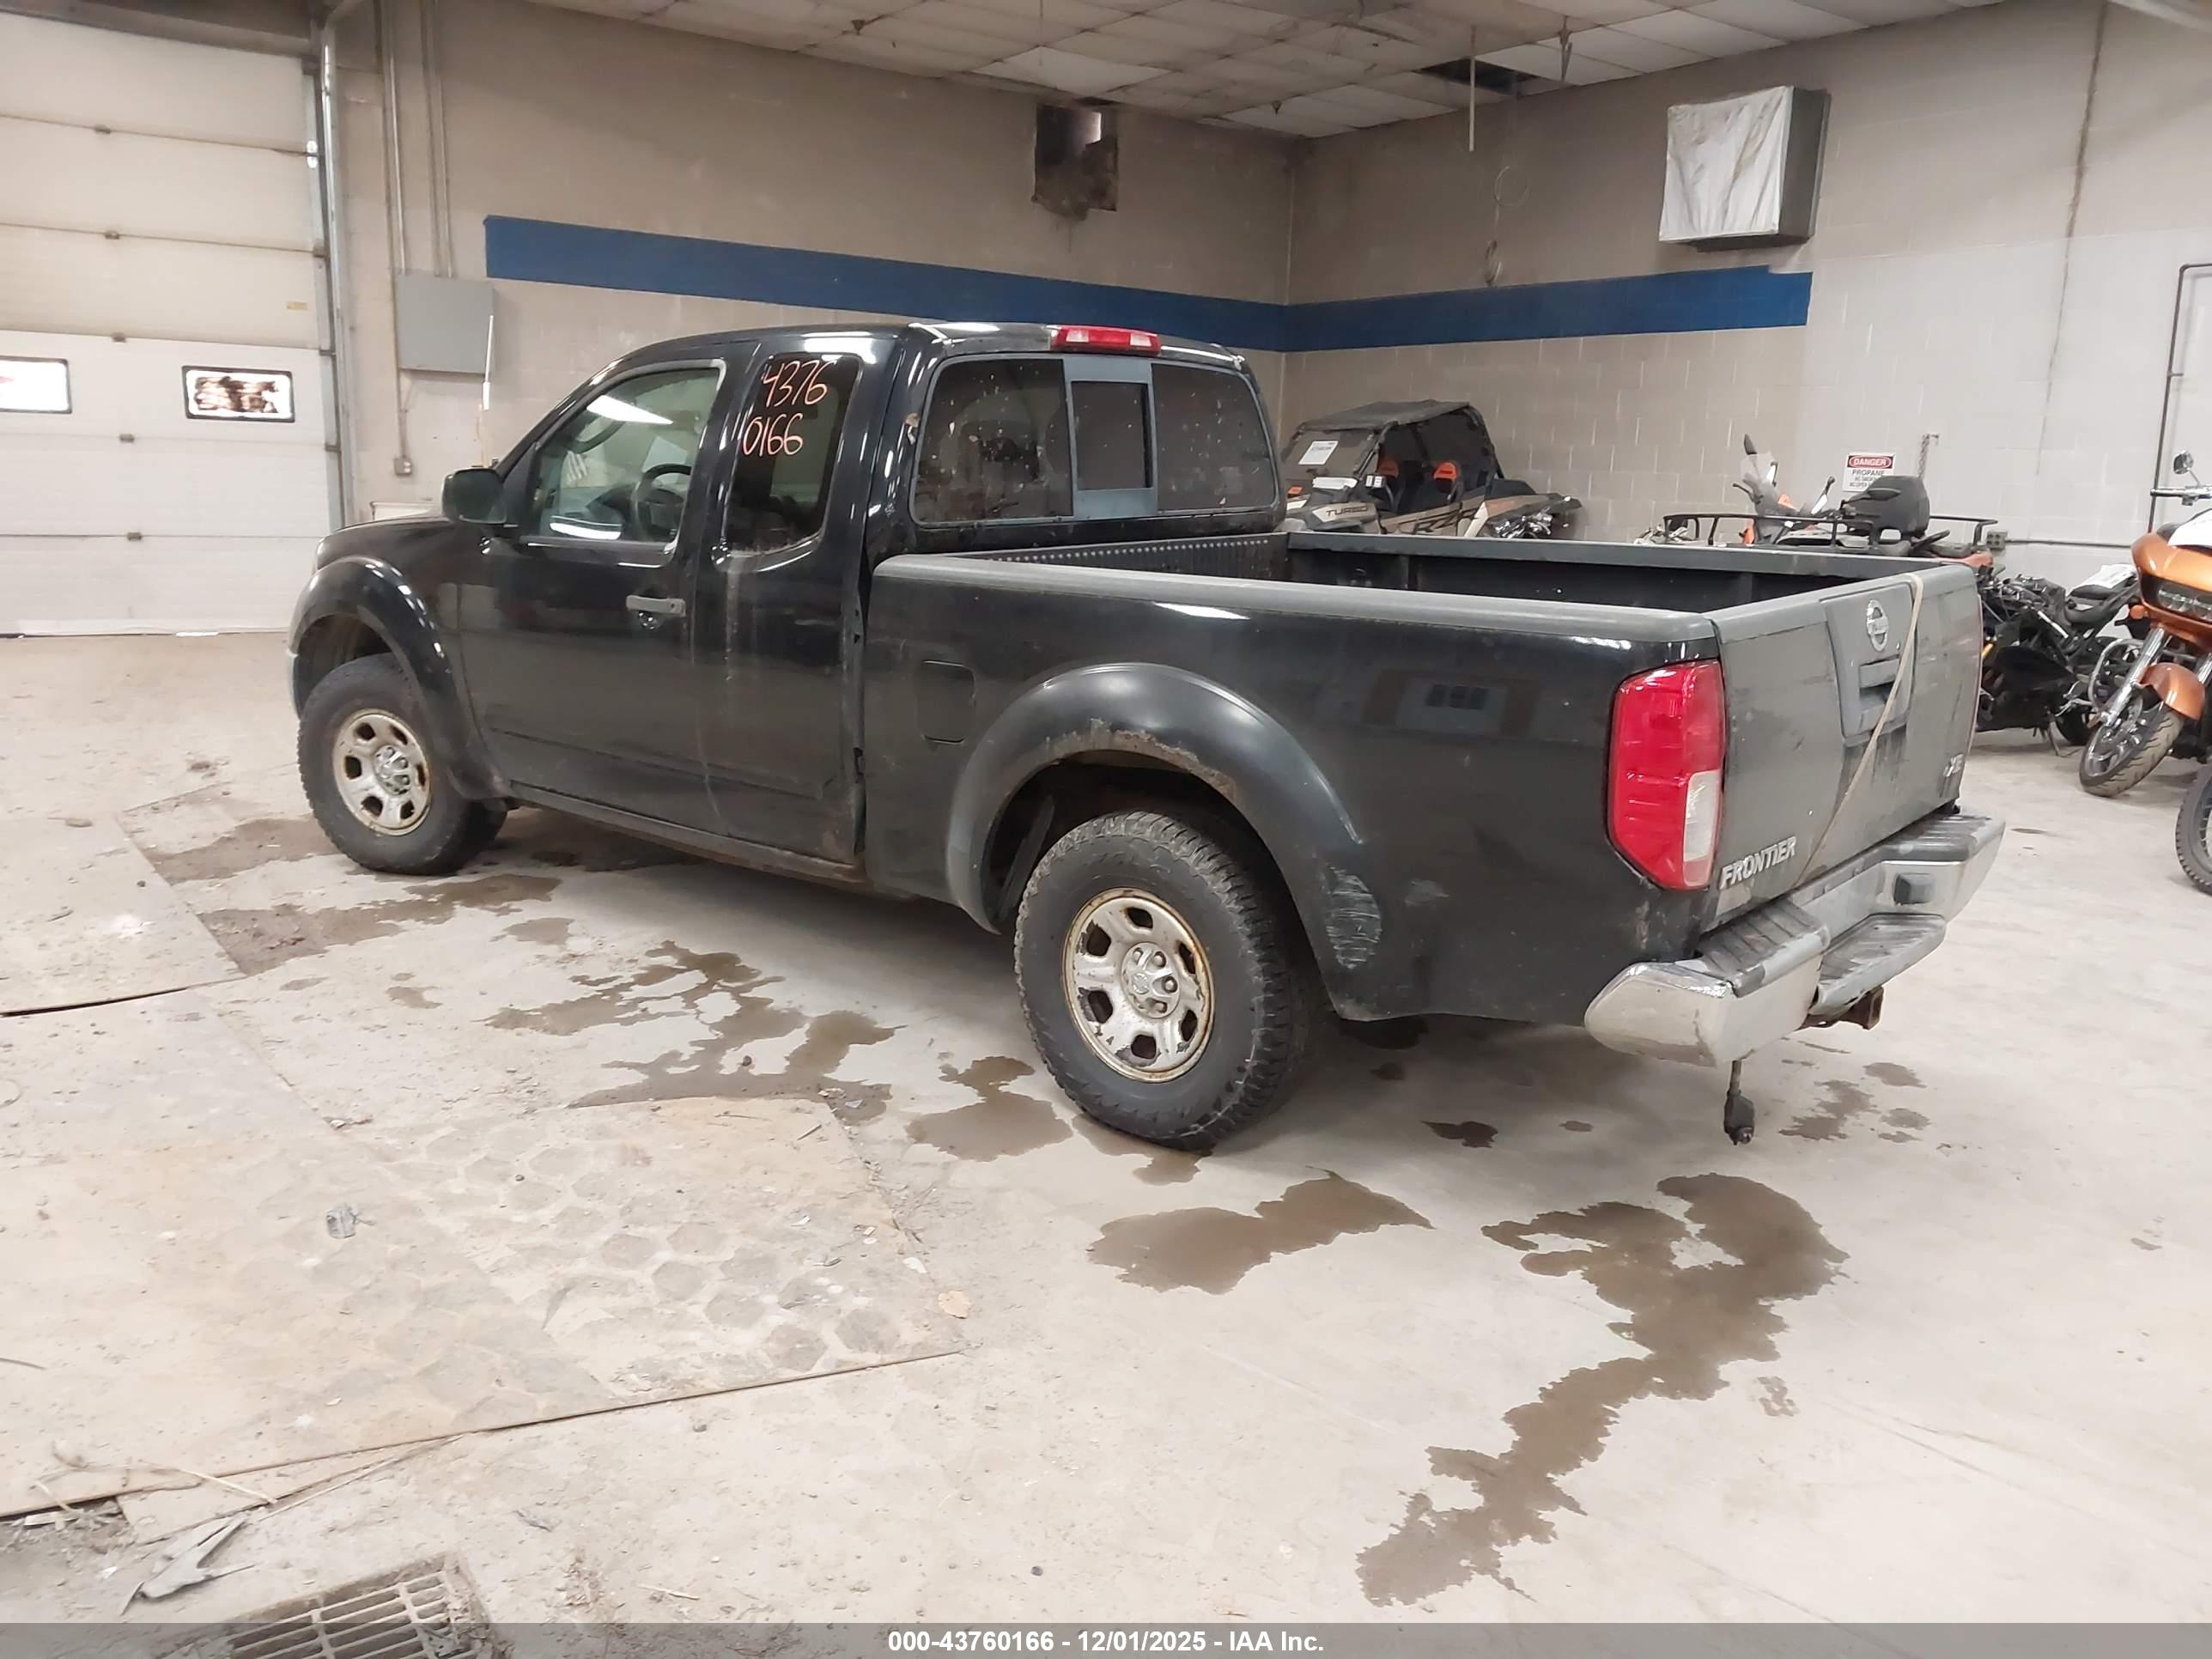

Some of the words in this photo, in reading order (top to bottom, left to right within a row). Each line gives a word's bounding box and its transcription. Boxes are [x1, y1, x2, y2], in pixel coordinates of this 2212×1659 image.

[761, 359, 838, 408] 4376
[743, 413, 803, 457] 0166
[1853, 458, 1887, 466] DANGER
[1326, 506, 1369, 517] TURBO
[1719, 836, 1796, 890] FRONTIER
